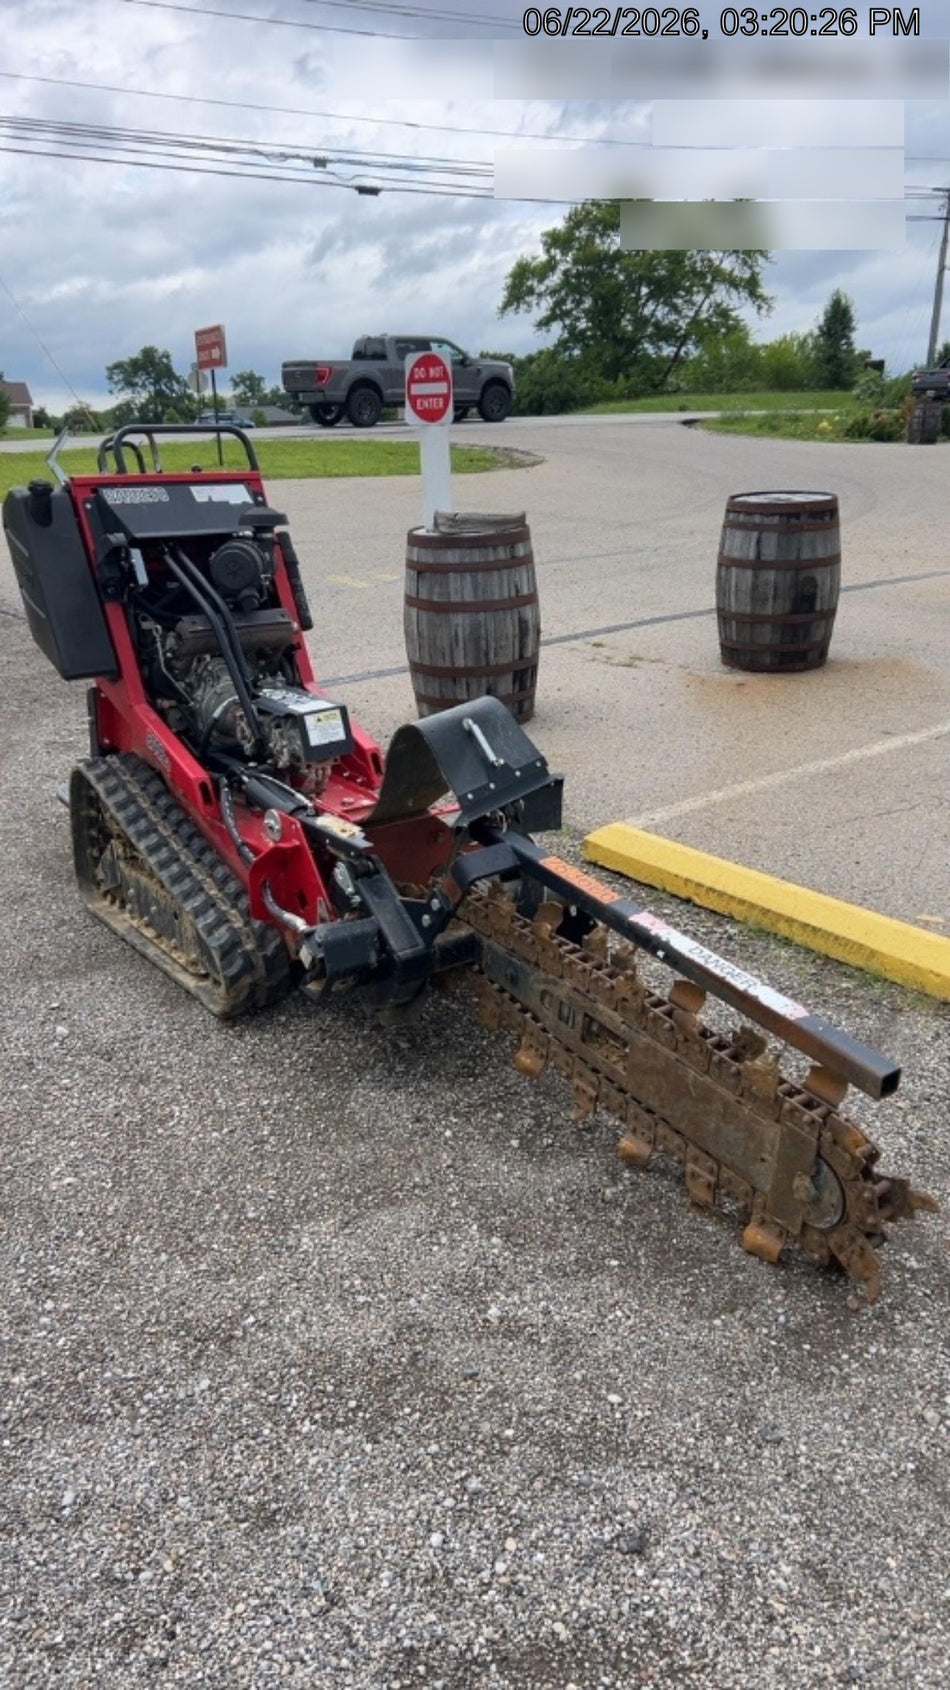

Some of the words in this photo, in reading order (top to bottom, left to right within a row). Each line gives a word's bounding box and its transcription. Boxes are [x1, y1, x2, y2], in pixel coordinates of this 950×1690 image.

[414, 367, 426, 378] DO
[429, 366, 444, 378] NOT
[417, 398, 444, 410] ENTER
[689, 946, 760, 991] DANGER
